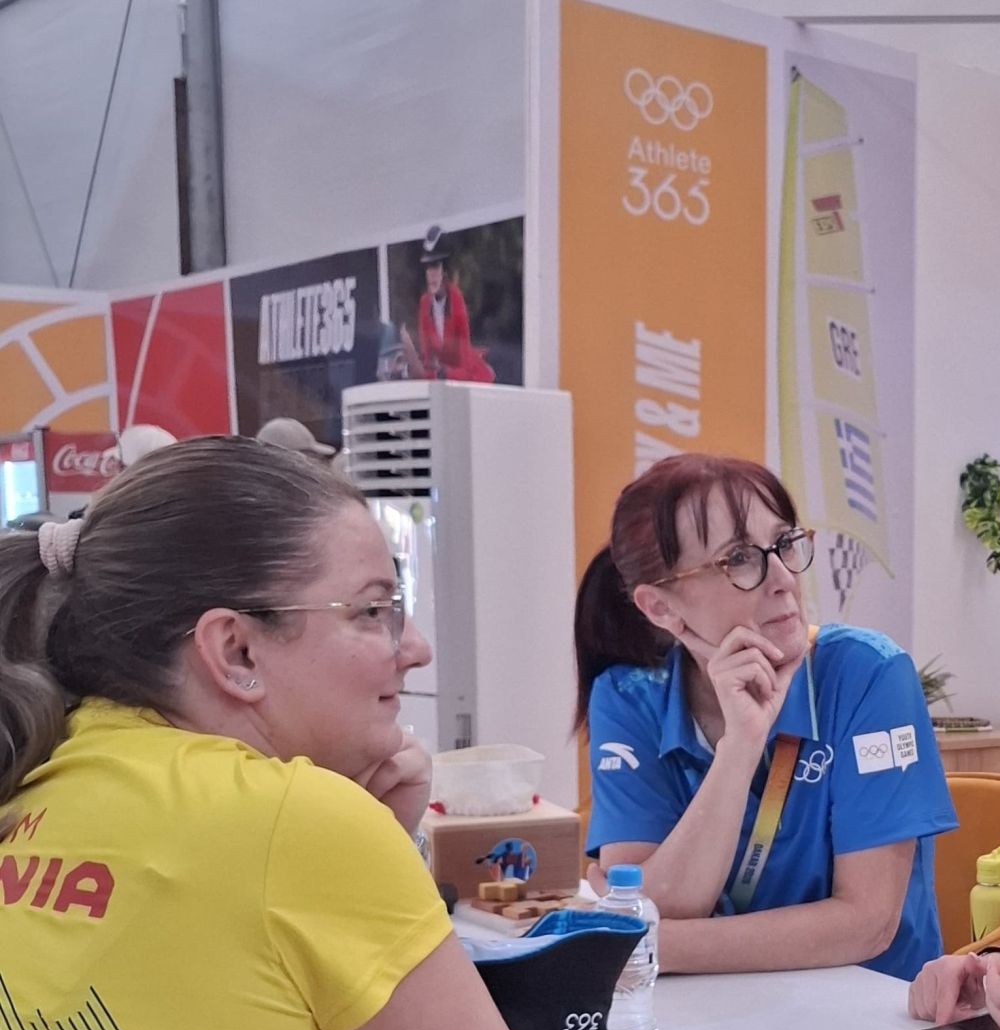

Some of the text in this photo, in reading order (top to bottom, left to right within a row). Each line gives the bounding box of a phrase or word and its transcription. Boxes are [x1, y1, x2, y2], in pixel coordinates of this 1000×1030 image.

[627, 135, 712, 175] Athlete
[622, 166, 711, 226] 365
[258, 276, 357, 364] ATHLETE365
[635, 320, 701, 400] ME
[598, 756, 622, 770] ANTA
